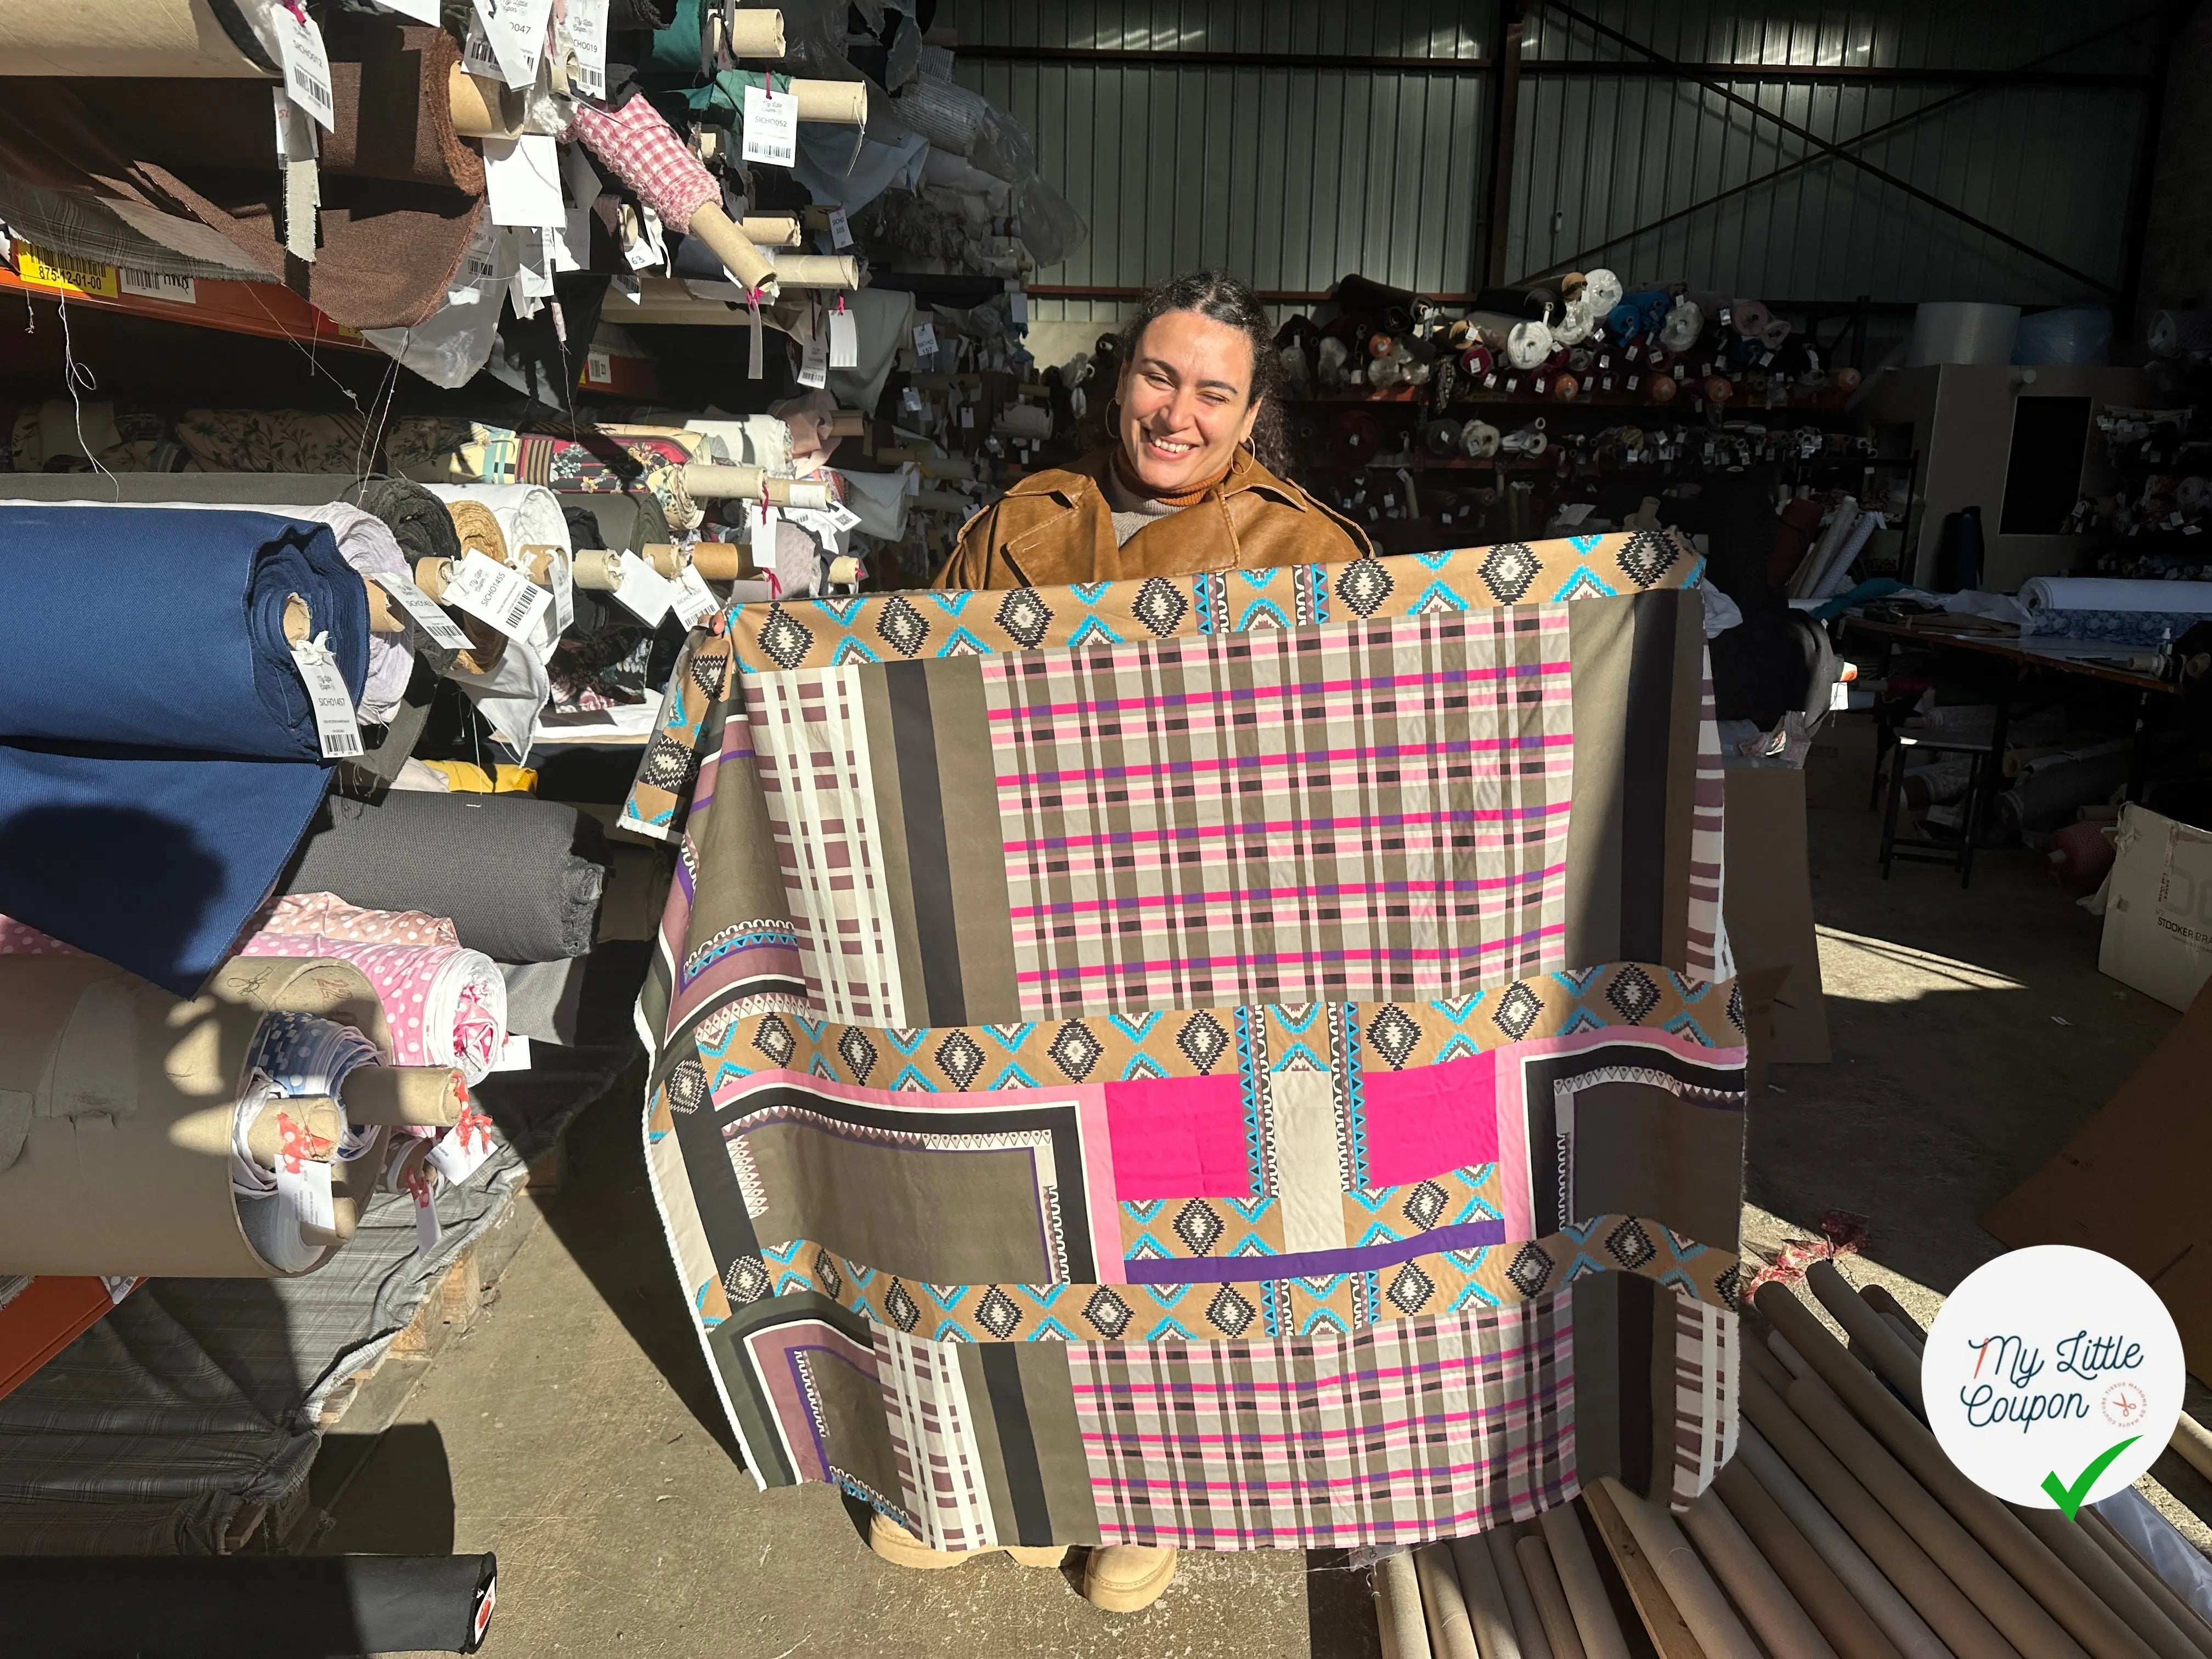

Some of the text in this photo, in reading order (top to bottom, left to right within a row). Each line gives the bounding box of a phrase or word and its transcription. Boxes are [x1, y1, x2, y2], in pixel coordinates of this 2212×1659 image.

[755, 116, 787, 127] SICHO052
[631, 256, 645, 265] 63
[38, 264, 102, 291] 875-12-01-00
[481, 572, 505, 606] SICHO1455
[319, 698, 345, 706] SICHO1457
[2158, 917, 2193, 939] STOOKER
